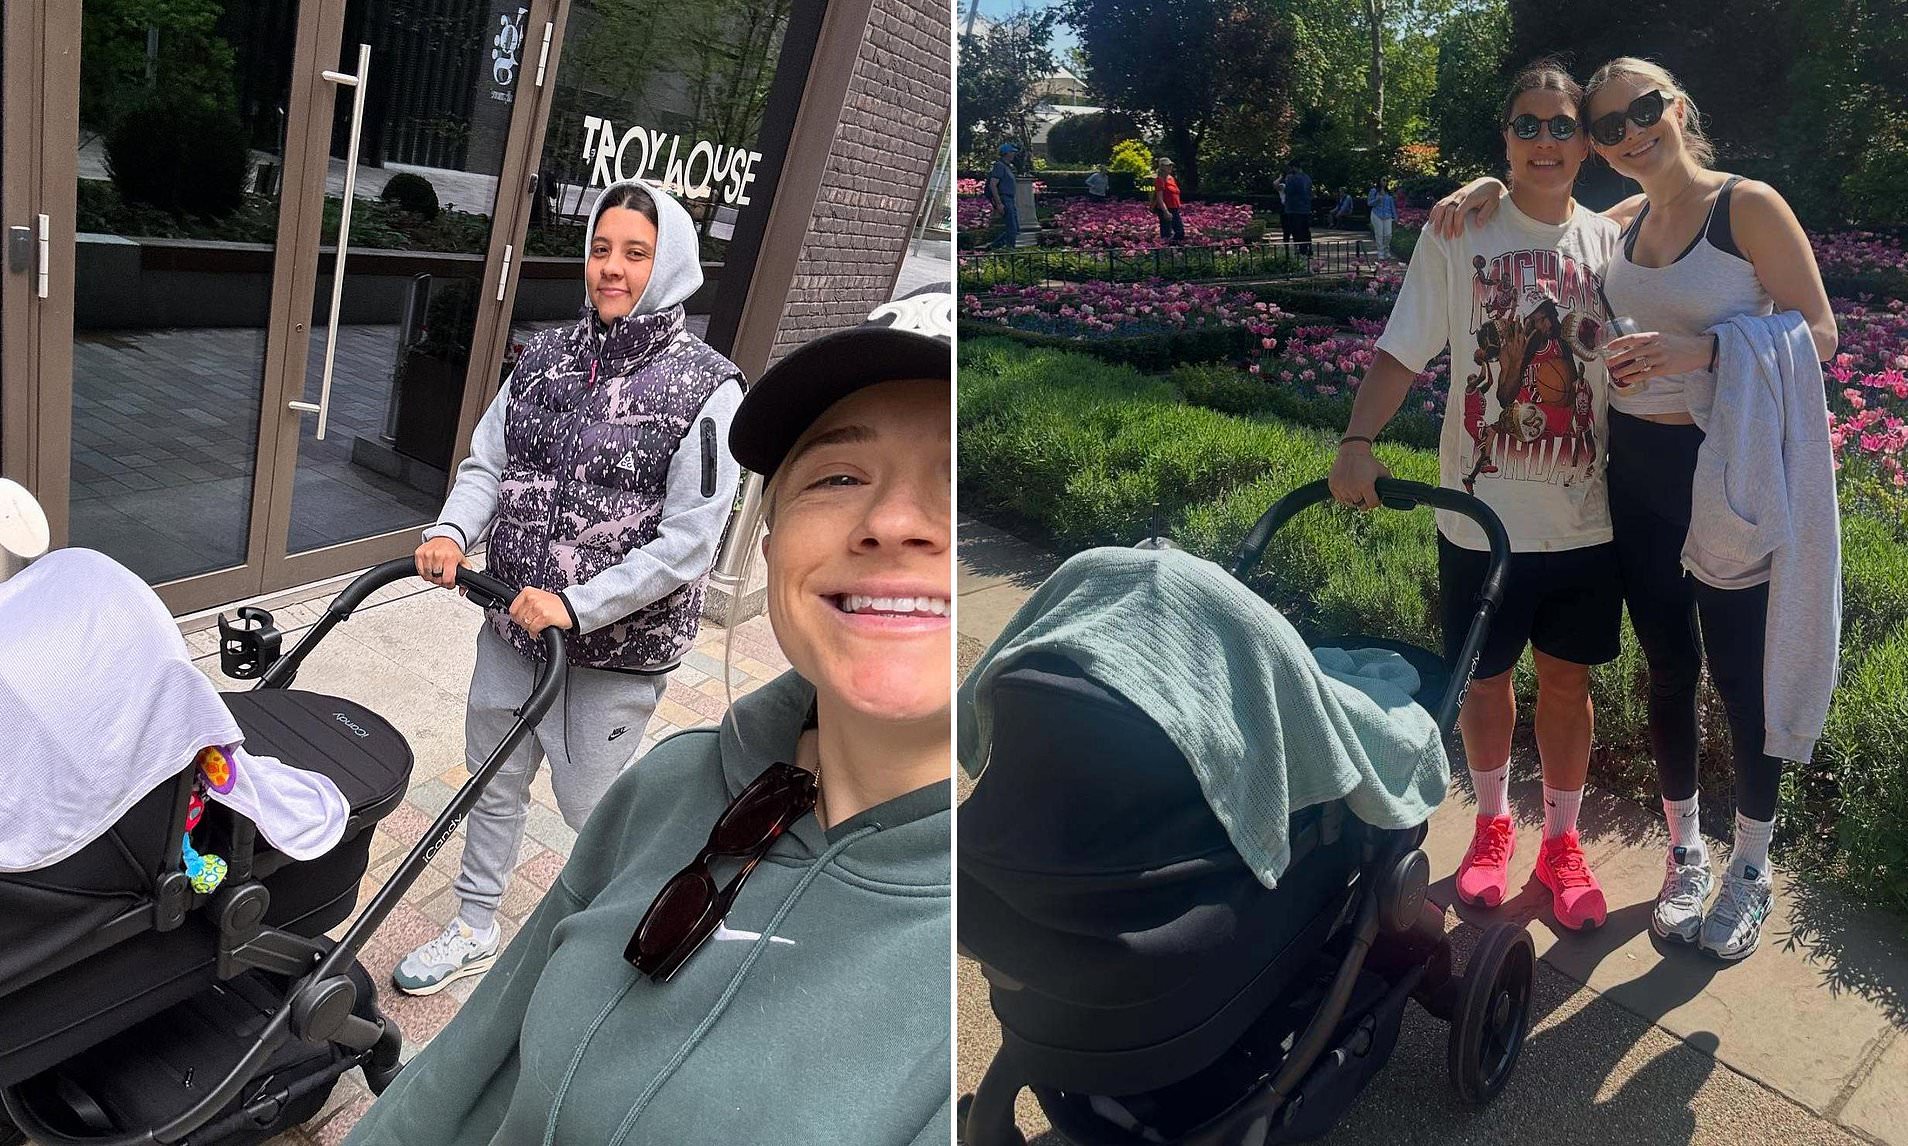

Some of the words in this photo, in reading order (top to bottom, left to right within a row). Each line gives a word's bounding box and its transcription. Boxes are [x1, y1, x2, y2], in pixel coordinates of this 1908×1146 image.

[582, 115, 667, 187] TROY
[1456, 650, 1480, 709] iCandy
[332, 713, 370, 739] iCandy
[422, 813, 462, 863] iCandy
